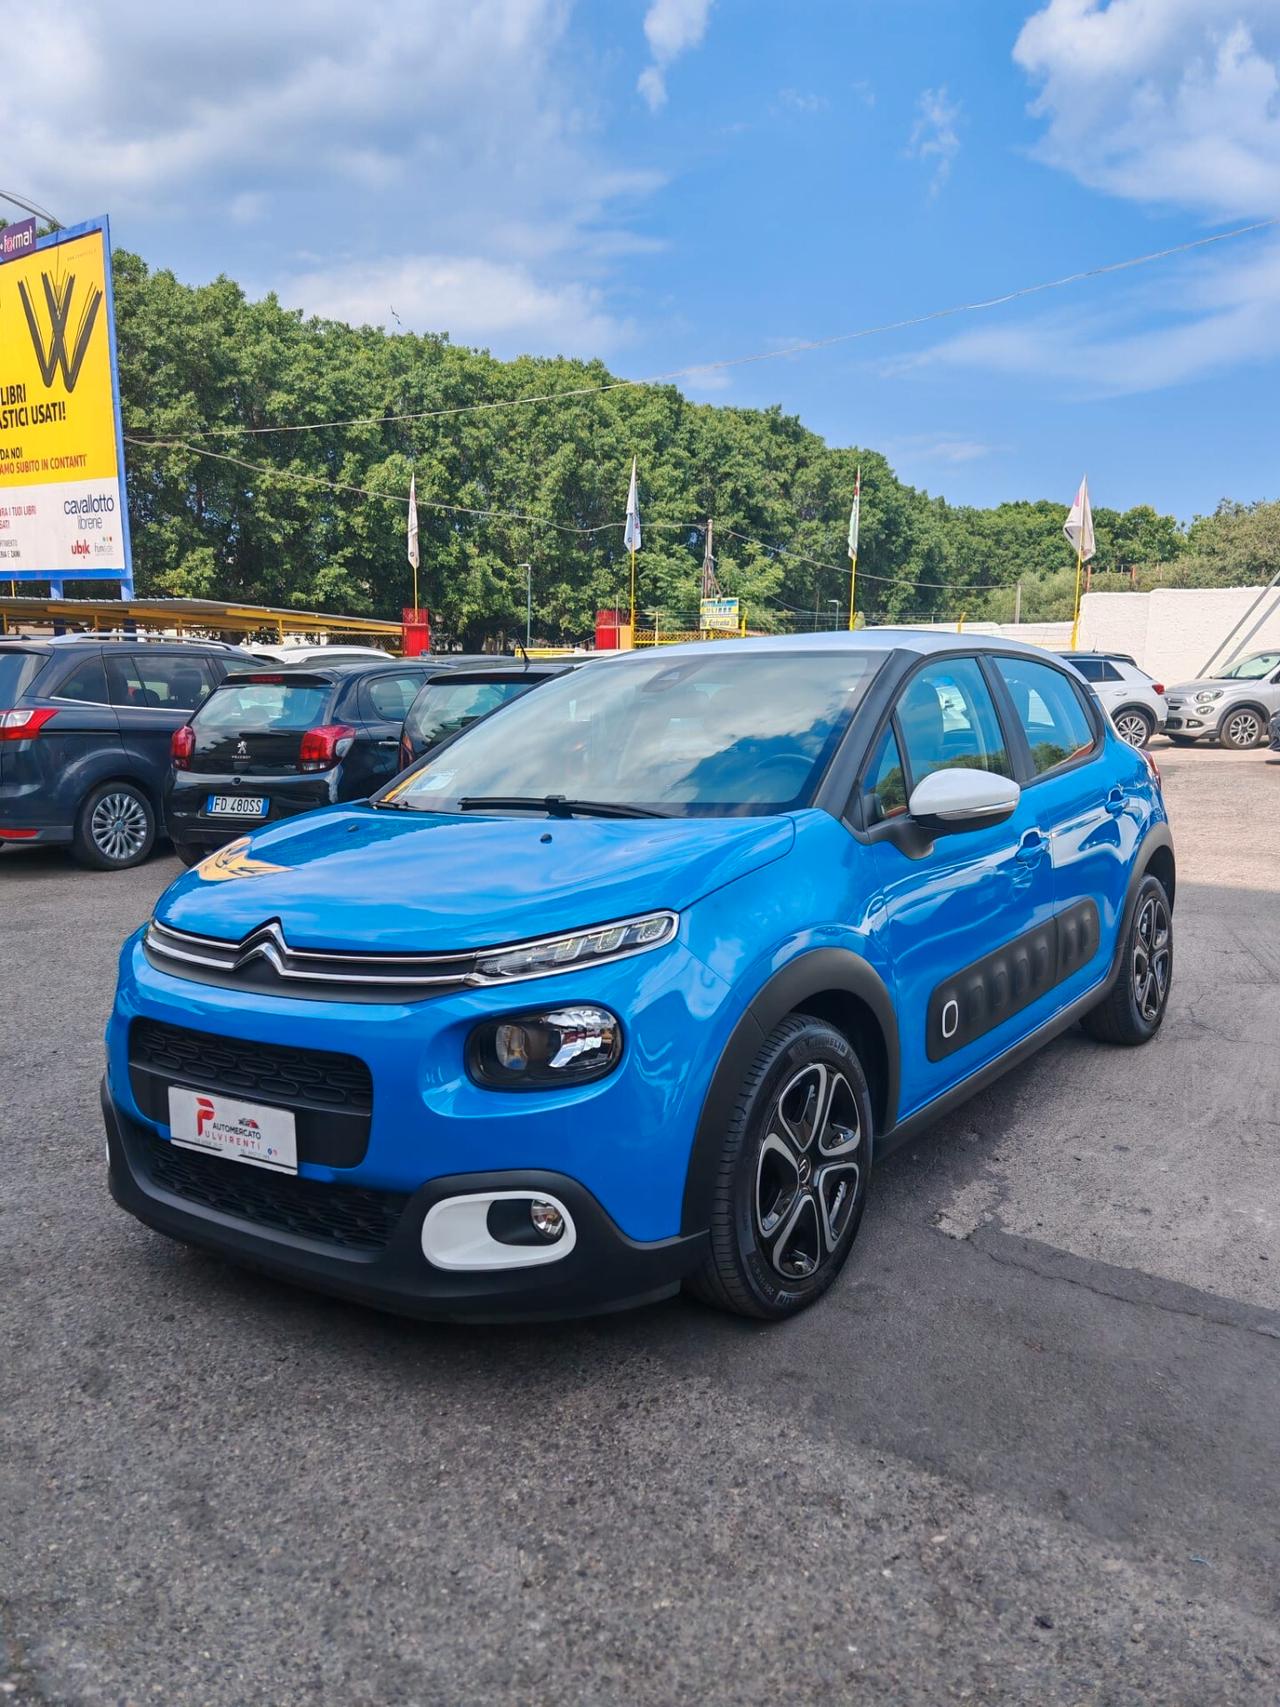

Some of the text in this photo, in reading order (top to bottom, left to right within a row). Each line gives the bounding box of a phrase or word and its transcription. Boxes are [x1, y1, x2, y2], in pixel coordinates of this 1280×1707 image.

[0, 384, 26, 406] LIBRI
[31, 401, 66, 425] USATI!
[16, 459, 40, 474] SUBITO
[41, 458, 49, 471] IN
[64, 494, 114, 514] cavallotto
[71, 539, 90, 559] ubik
[214, 797, 262, 813] FD 480SS
[212, 1122, 261, 1140] AUTOMERCATO
